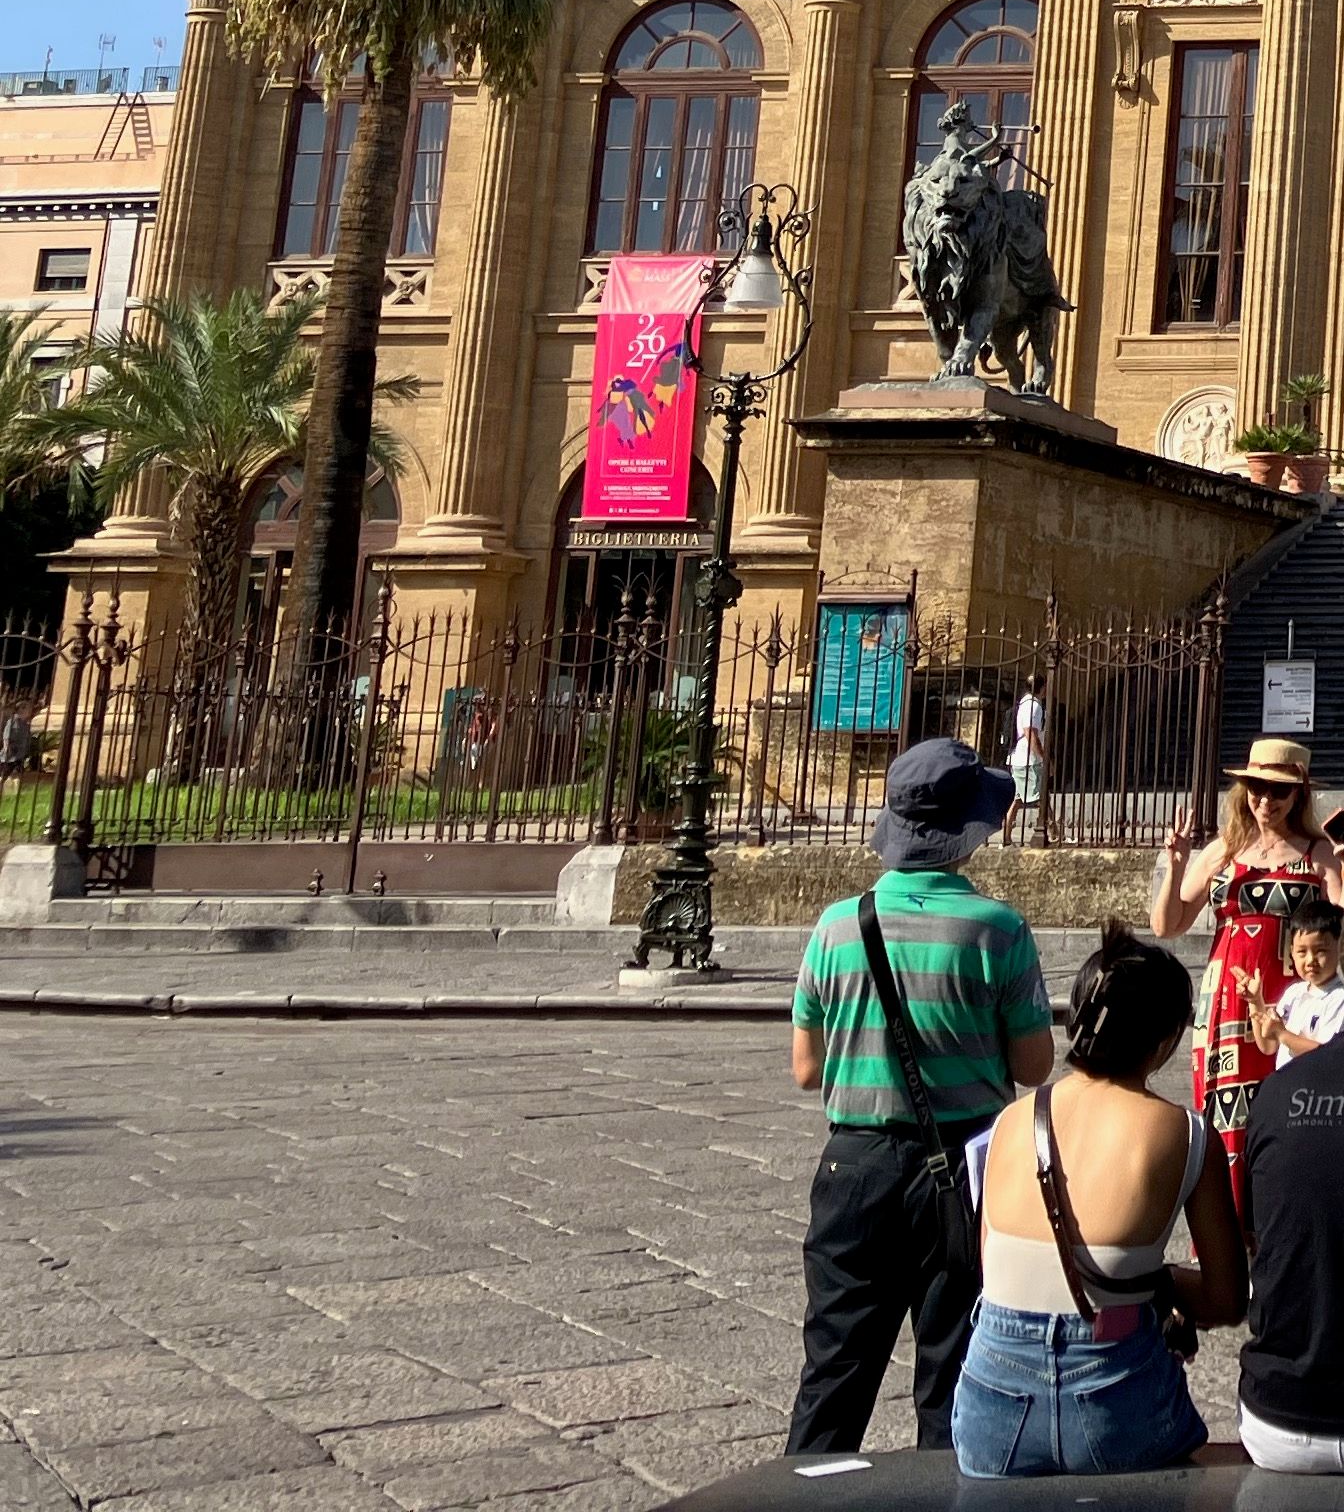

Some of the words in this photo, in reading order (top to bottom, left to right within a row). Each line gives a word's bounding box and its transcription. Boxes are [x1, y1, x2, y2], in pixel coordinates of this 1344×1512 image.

[636, 313, 665, 354] 26
[626, 339, 658, 383] 27
[573, 531, 700, 547] BIGLIETTERIA
